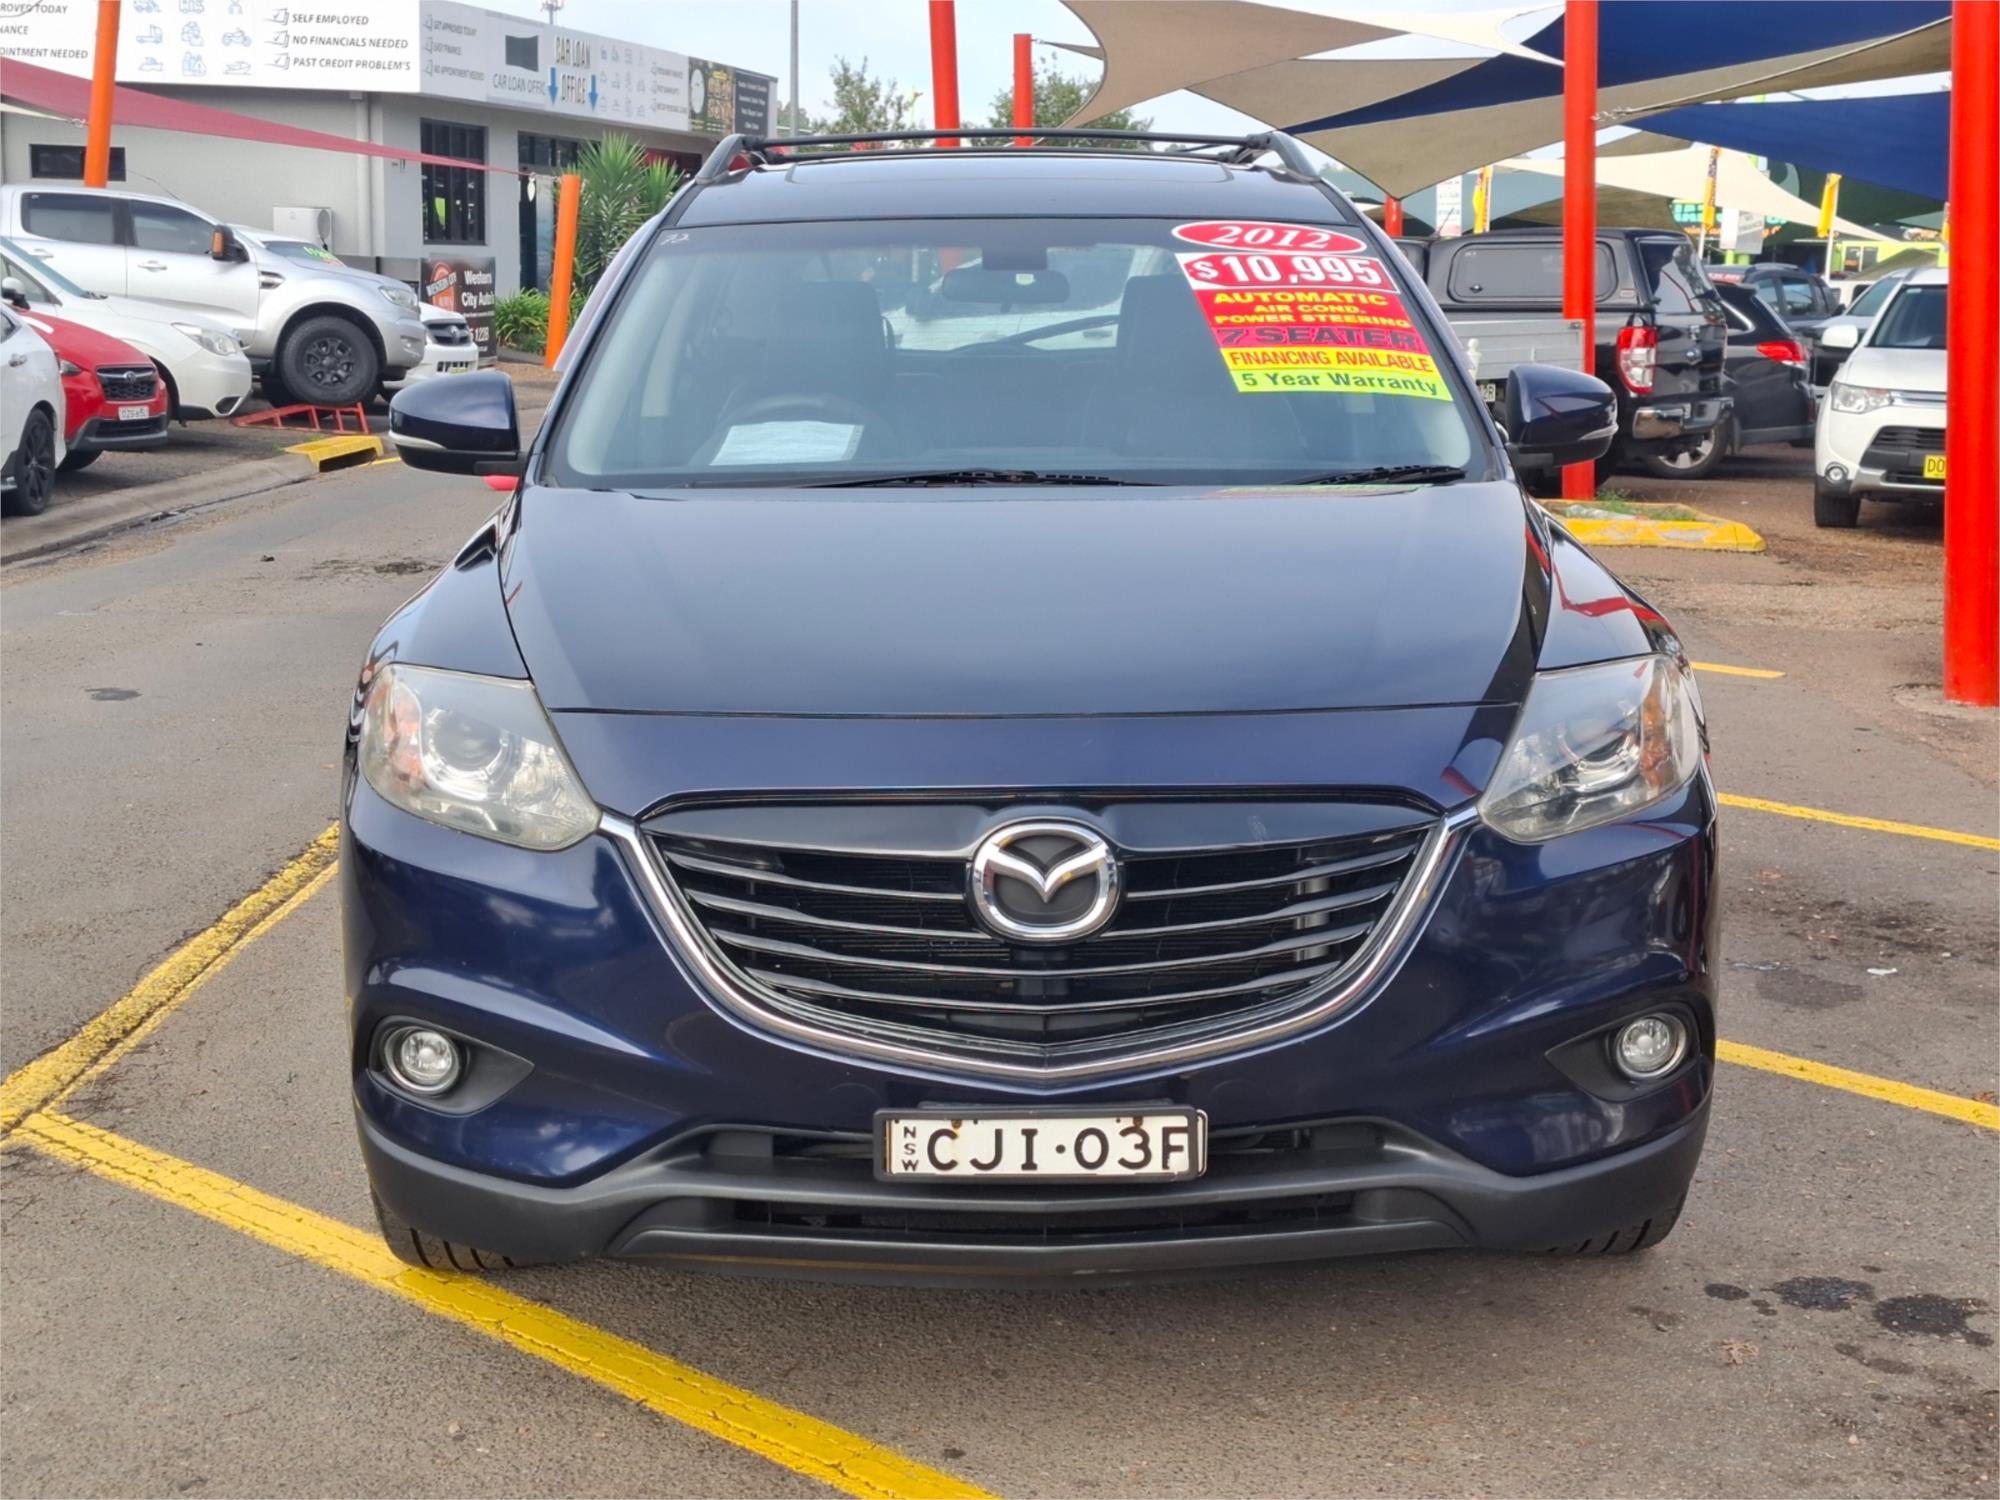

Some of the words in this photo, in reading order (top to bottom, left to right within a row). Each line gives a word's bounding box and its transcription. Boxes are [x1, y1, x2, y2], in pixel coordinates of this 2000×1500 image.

[35, 4, 68, 14] TODAY
[292, 14, 314, 23] SELF
[316, 15, 369, 25] EMPLOYED
[293, 35, 308, 45] NO
[310, 36, 367, 47] FINANCIALS
[369, 39, 408, 49] NEEDED
[50, 48, 88, 59] NEEDED
[555, 36, 571, 66] CAR
[572, 40, 591, 69] LOAN
[293, 57, 316, 67] PAST
[319, 58, 353, 69] CREDIT
[355, 60, 411, 71] PROBLEM'S
[493, 73, 506, 89] CAR
[508, 76, 526, 92] LOAN
[561, 74, 586, 104] OFFICE
[1210, 224, 1332, 249] 2012
[464, 270, 492, 285] Western
[1192, 255, 1383, 285] $10,995
[461, 291, 477, 309] City
[1213, 292, 1389, 306] AUTOMATIC
[1254, 304, 1295, 313] AIR
[1299, 305, 1366, 315] COND.
[1214, 313, 1295, 323] POWER
[1302, 314, 1412, 328] STEERING
[1217, 328, 1249, 345] 7
[1255, 327, 1418, 350] SEATER
[1230, 350, 1331, 366] FINANCING
[1336, 351, 1433, 373] AVAILABLE
[1242, 373, 1258, 387] 5
[1266, 372, 1321, 389] Year
[1334, 373, 1438, 396] Warranty
[901, 1126, 919, 1172] NSW
